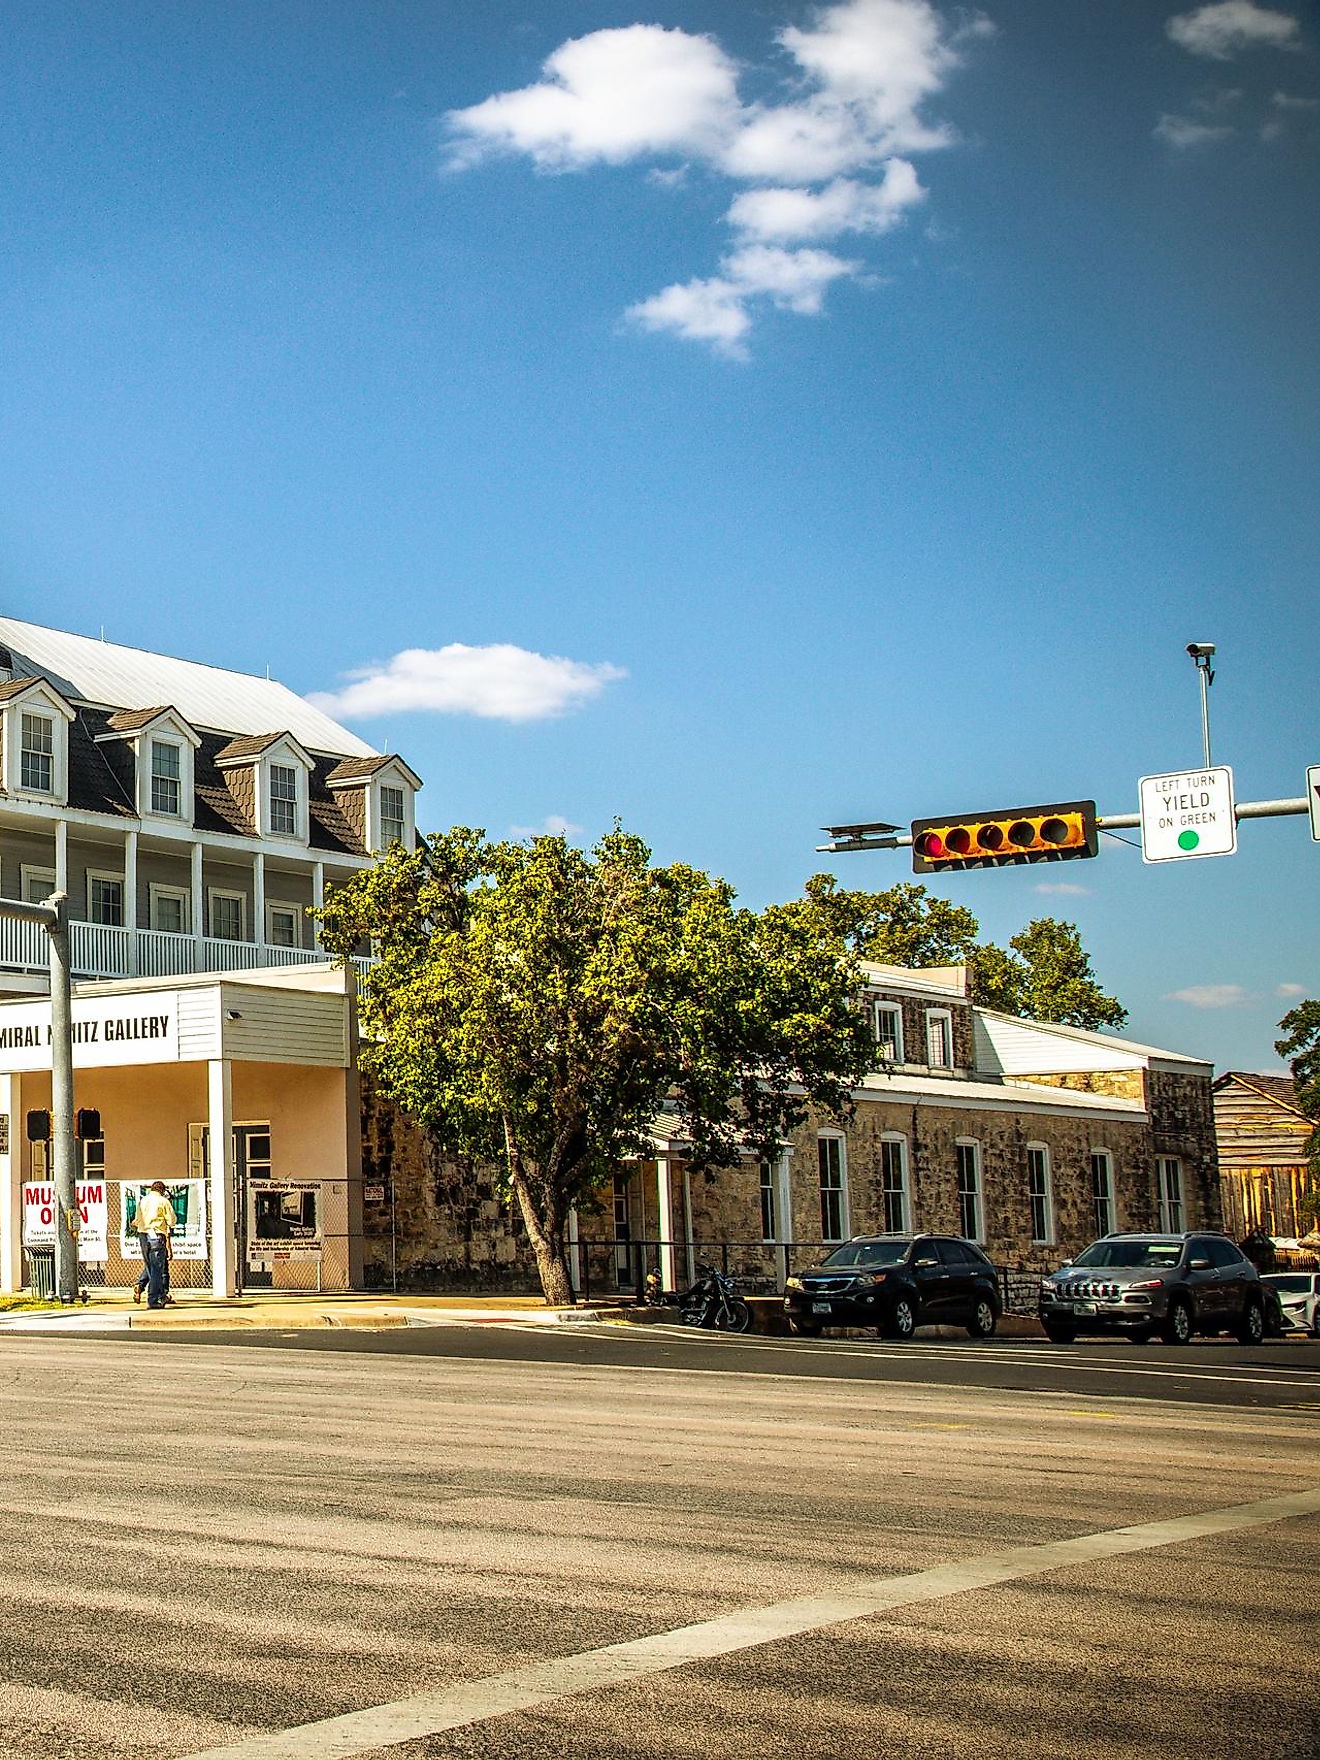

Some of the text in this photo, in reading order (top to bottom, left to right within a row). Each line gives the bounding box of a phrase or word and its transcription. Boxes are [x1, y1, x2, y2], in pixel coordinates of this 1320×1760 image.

[1155, 775, 1215, 793] LEFT TURN
[1162, 792, 1210, 811] YIELD
[1159, 812, 1216, 829] ON GREEN
[104, 1016, 169, 1041] GALLERY
[25, 1185, 103, 1205] MUUM
[269, 1182, 289, 1190] Gallery
[40, 1206, 89, 1224] ON
